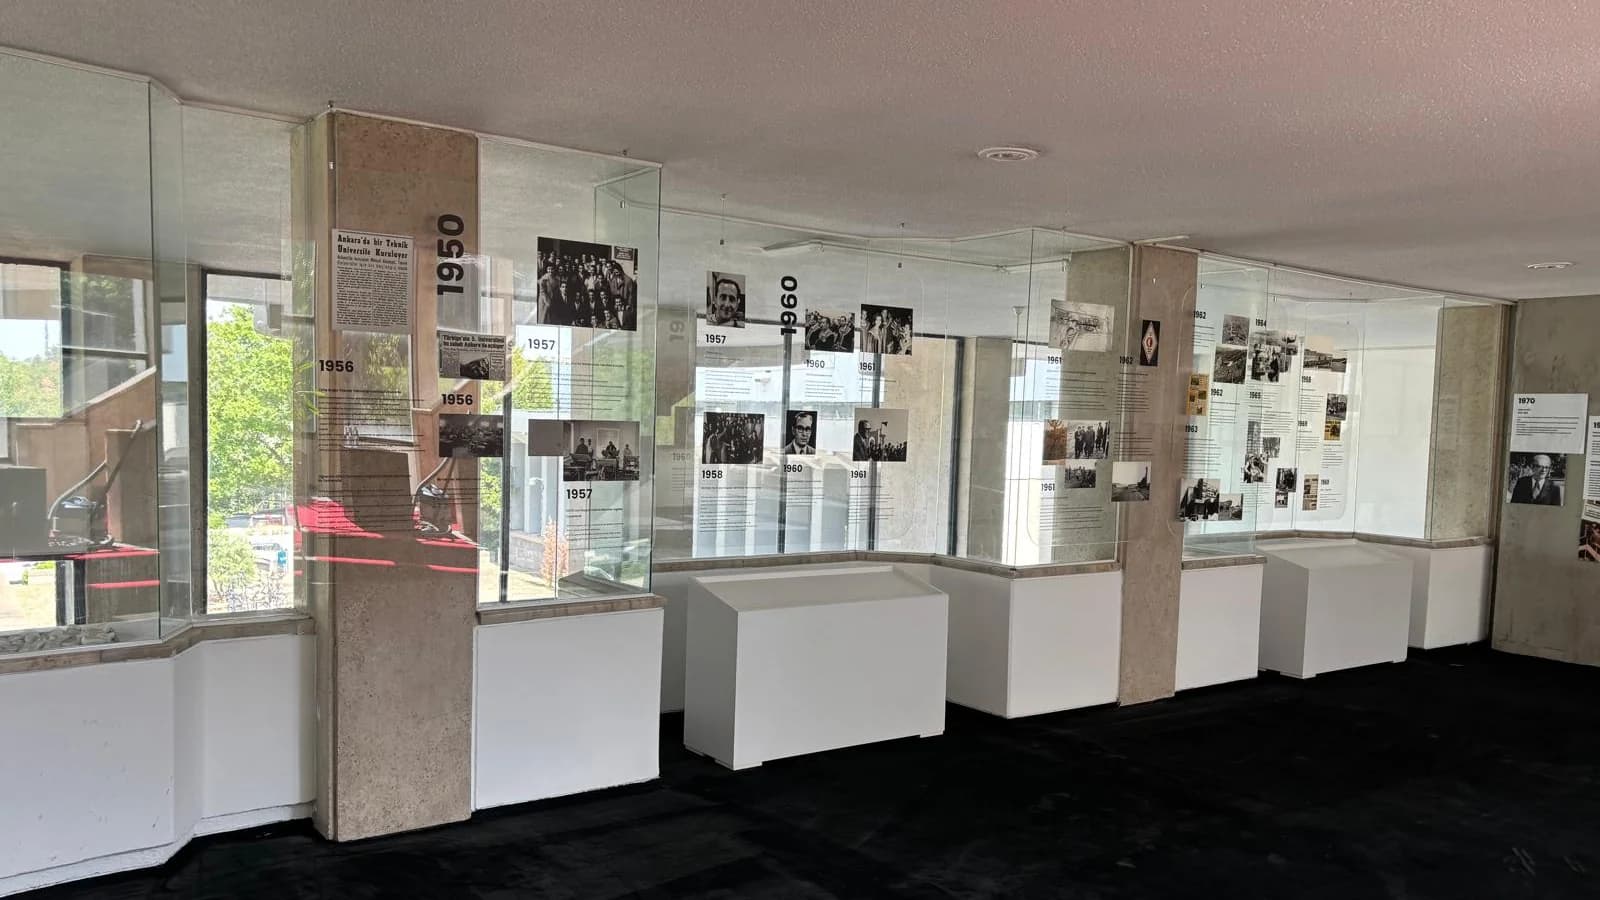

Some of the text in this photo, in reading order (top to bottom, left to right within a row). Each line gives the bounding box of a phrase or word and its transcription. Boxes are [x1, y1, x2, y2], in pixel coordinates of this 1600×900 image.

[337, 234, 370, 245] Ankara'da
[386, 239, 408, 249] Teknik
[437, 214, 464, 295] 1950
[780, 275, 798, 336] 1960
[527, 338, 556, 351] 1957
[705, 333, 727, 345] 1957
[806, 359, 825, 369] 1960
[859, 361, 876, 371] 1961
[1047, 355, 1062, 365] 1961
[319, 360, 354, 373] 1956
[441, 393, 473, 405] 1956
[783, 464, 803, 473] 1960
[851, 470, 867, 479] 1961
[701, 470, 723, 480] 1958
[1041, 483, 1056, 492] 1961
[566, 488, 593, 500] 1957
